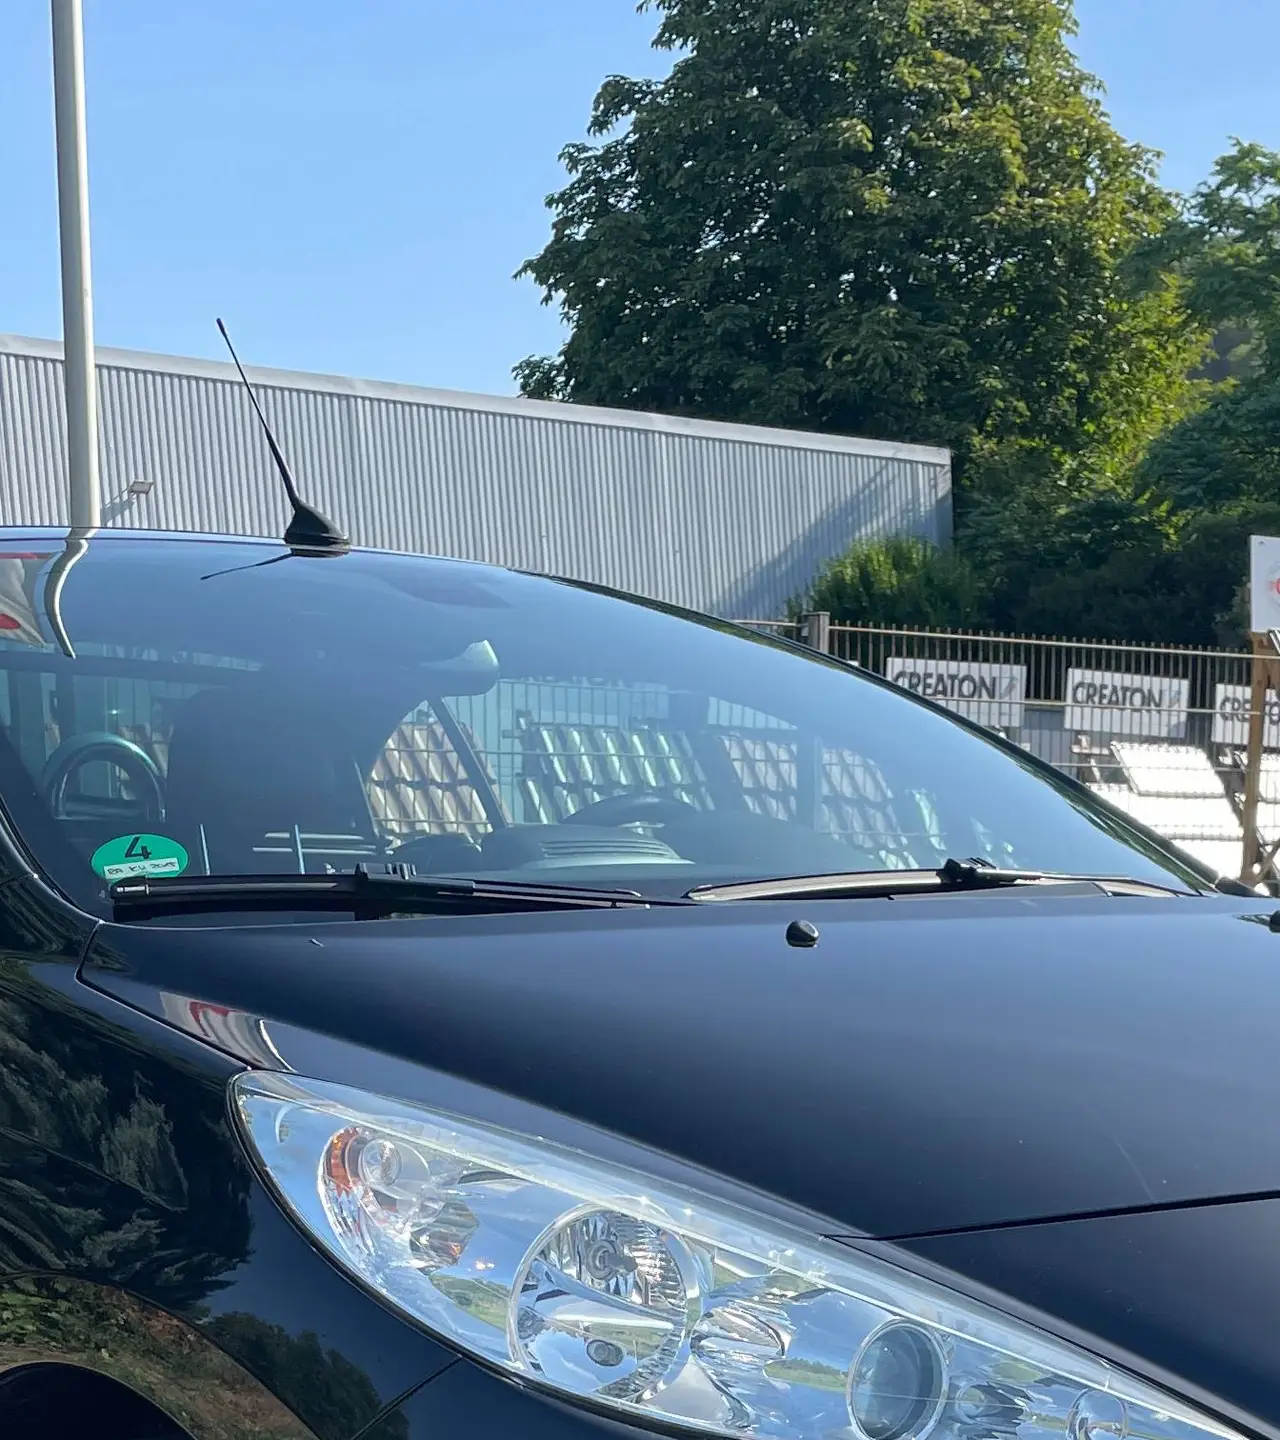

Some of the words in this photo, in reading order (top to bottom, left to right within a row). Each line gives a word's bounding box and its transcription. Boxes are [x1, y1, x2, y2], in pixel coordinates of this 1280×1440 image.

[893, 670, 997, 699] CREATON
[1072, 681, 1163, 713] CREATON
[124, 836, 152, 859] 4
